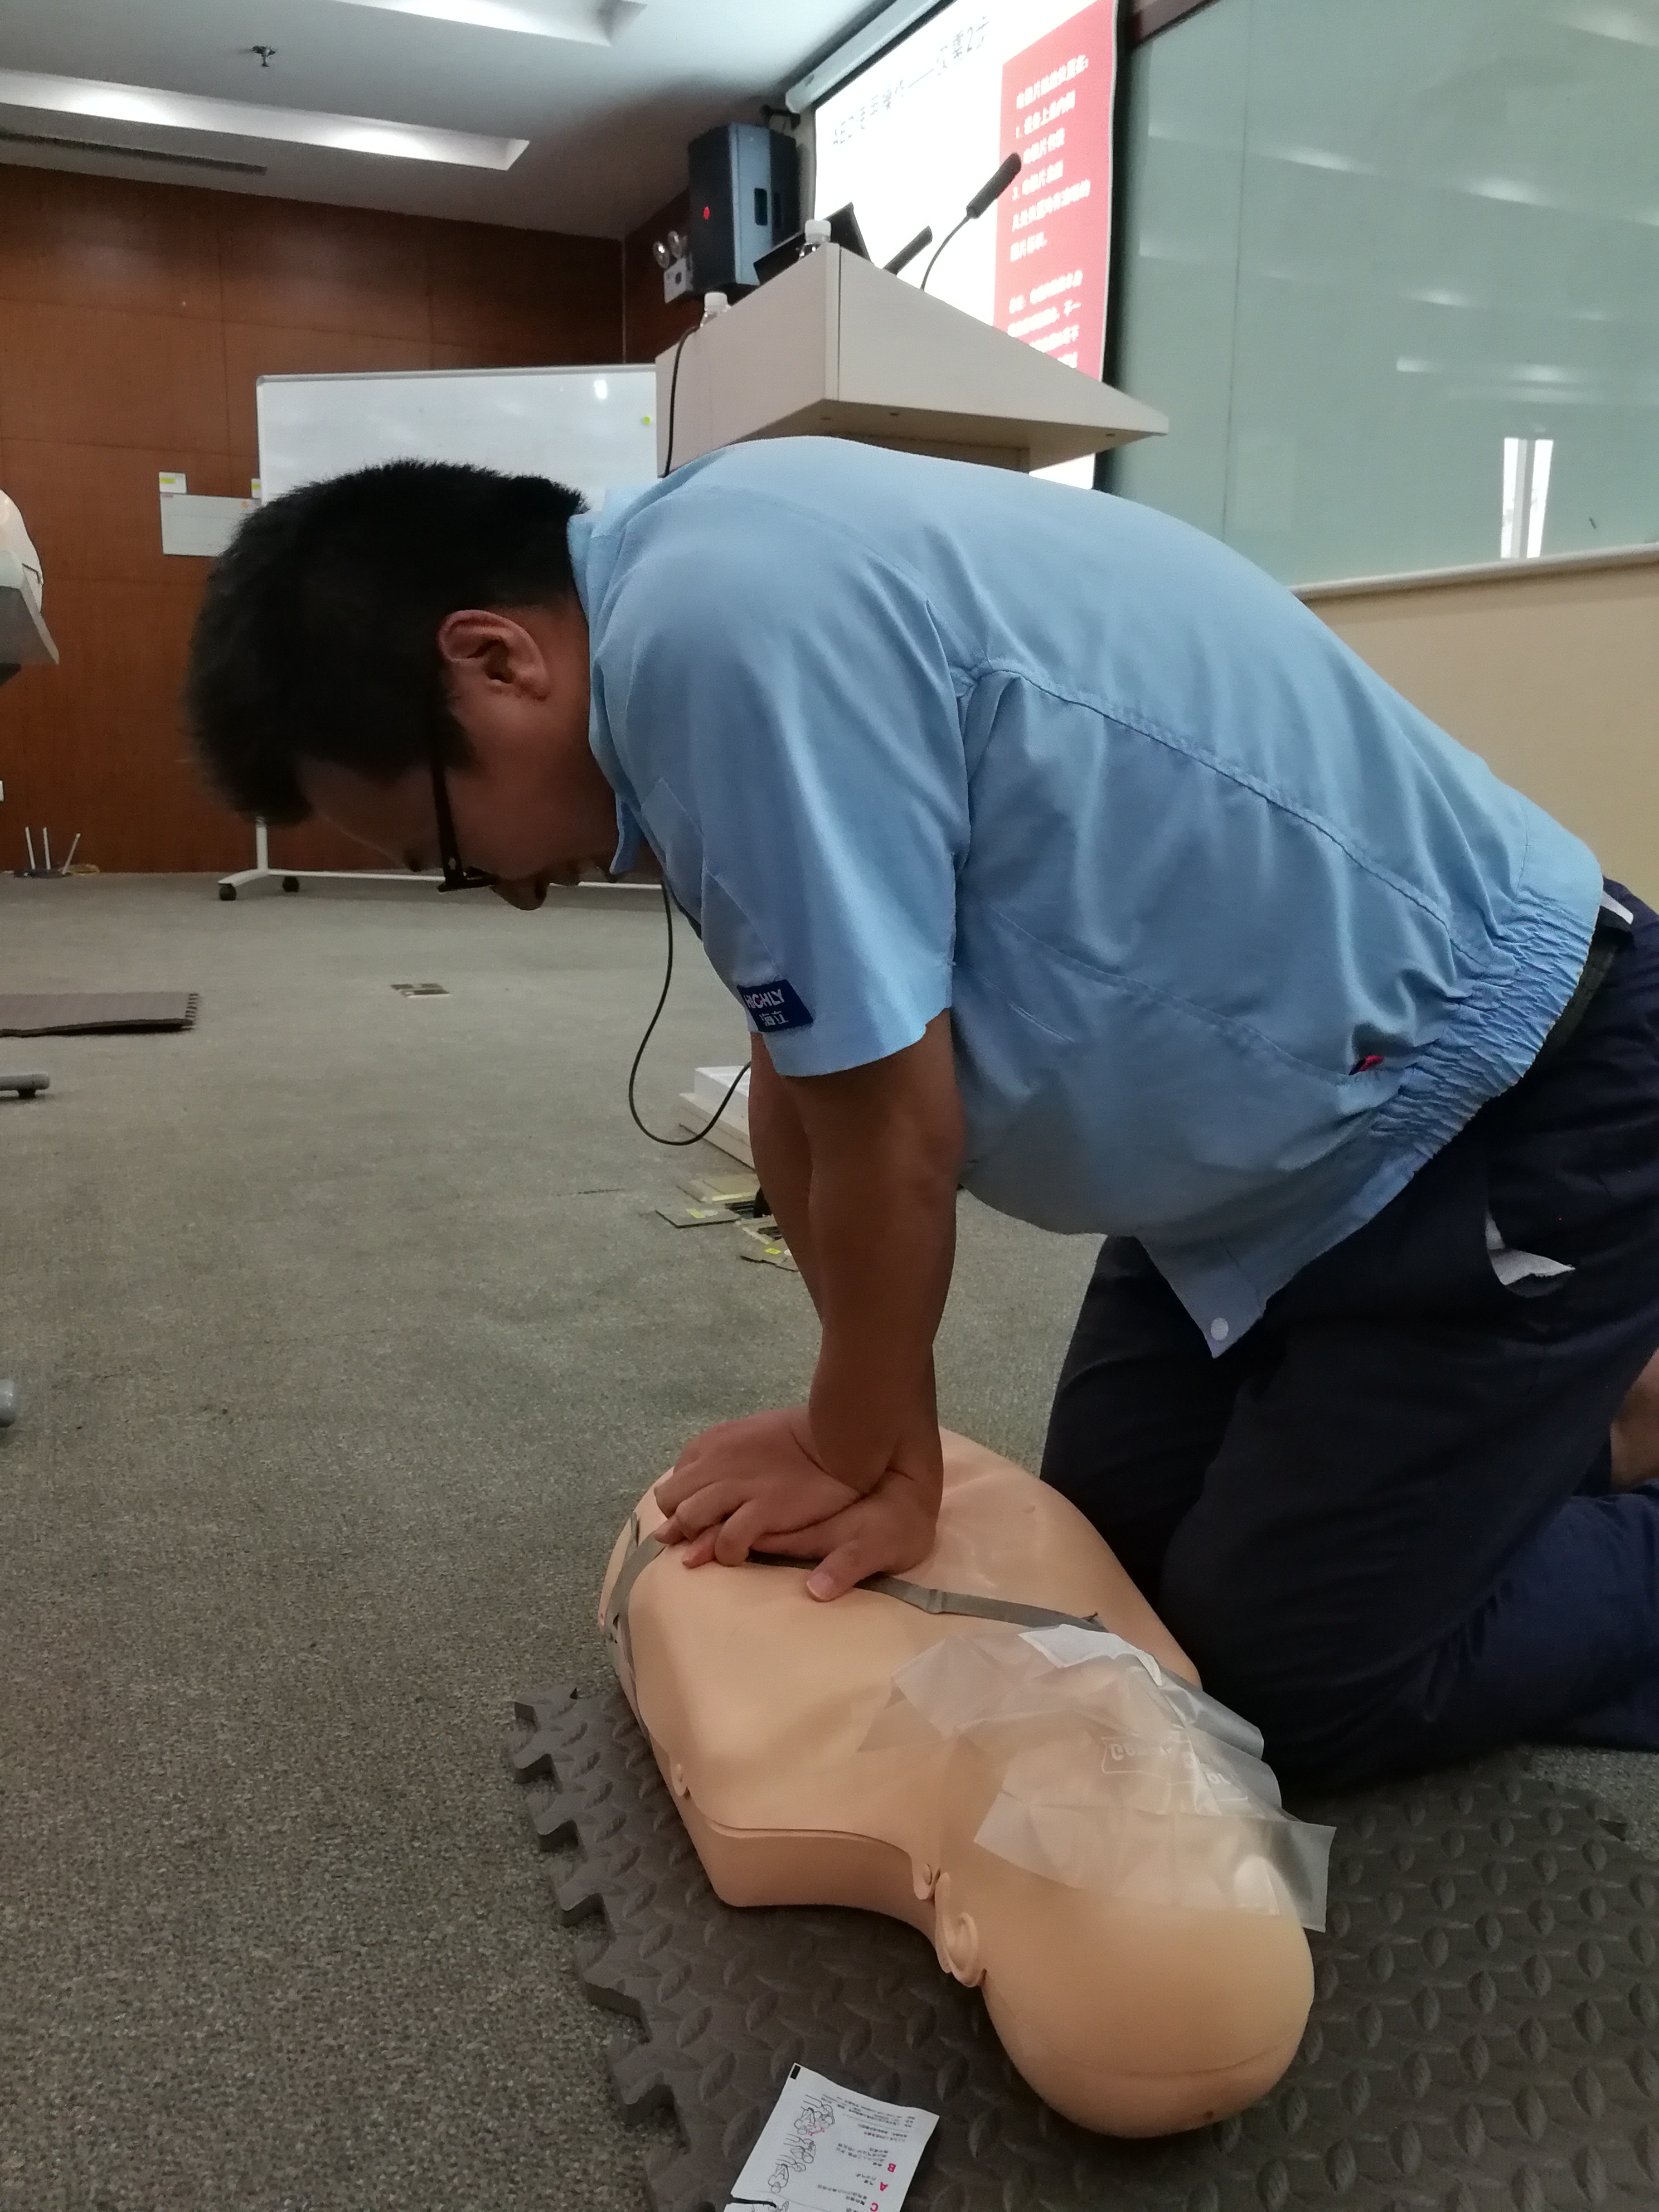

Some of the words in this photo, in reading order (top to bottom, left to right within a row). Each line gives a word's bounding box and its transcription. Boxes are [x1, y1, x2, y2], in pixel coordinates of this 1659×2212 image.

[887, 2163, 896, 2172] B
[880, 2182, 888, 2191] A
[870, 2203, 879, 2212] C
